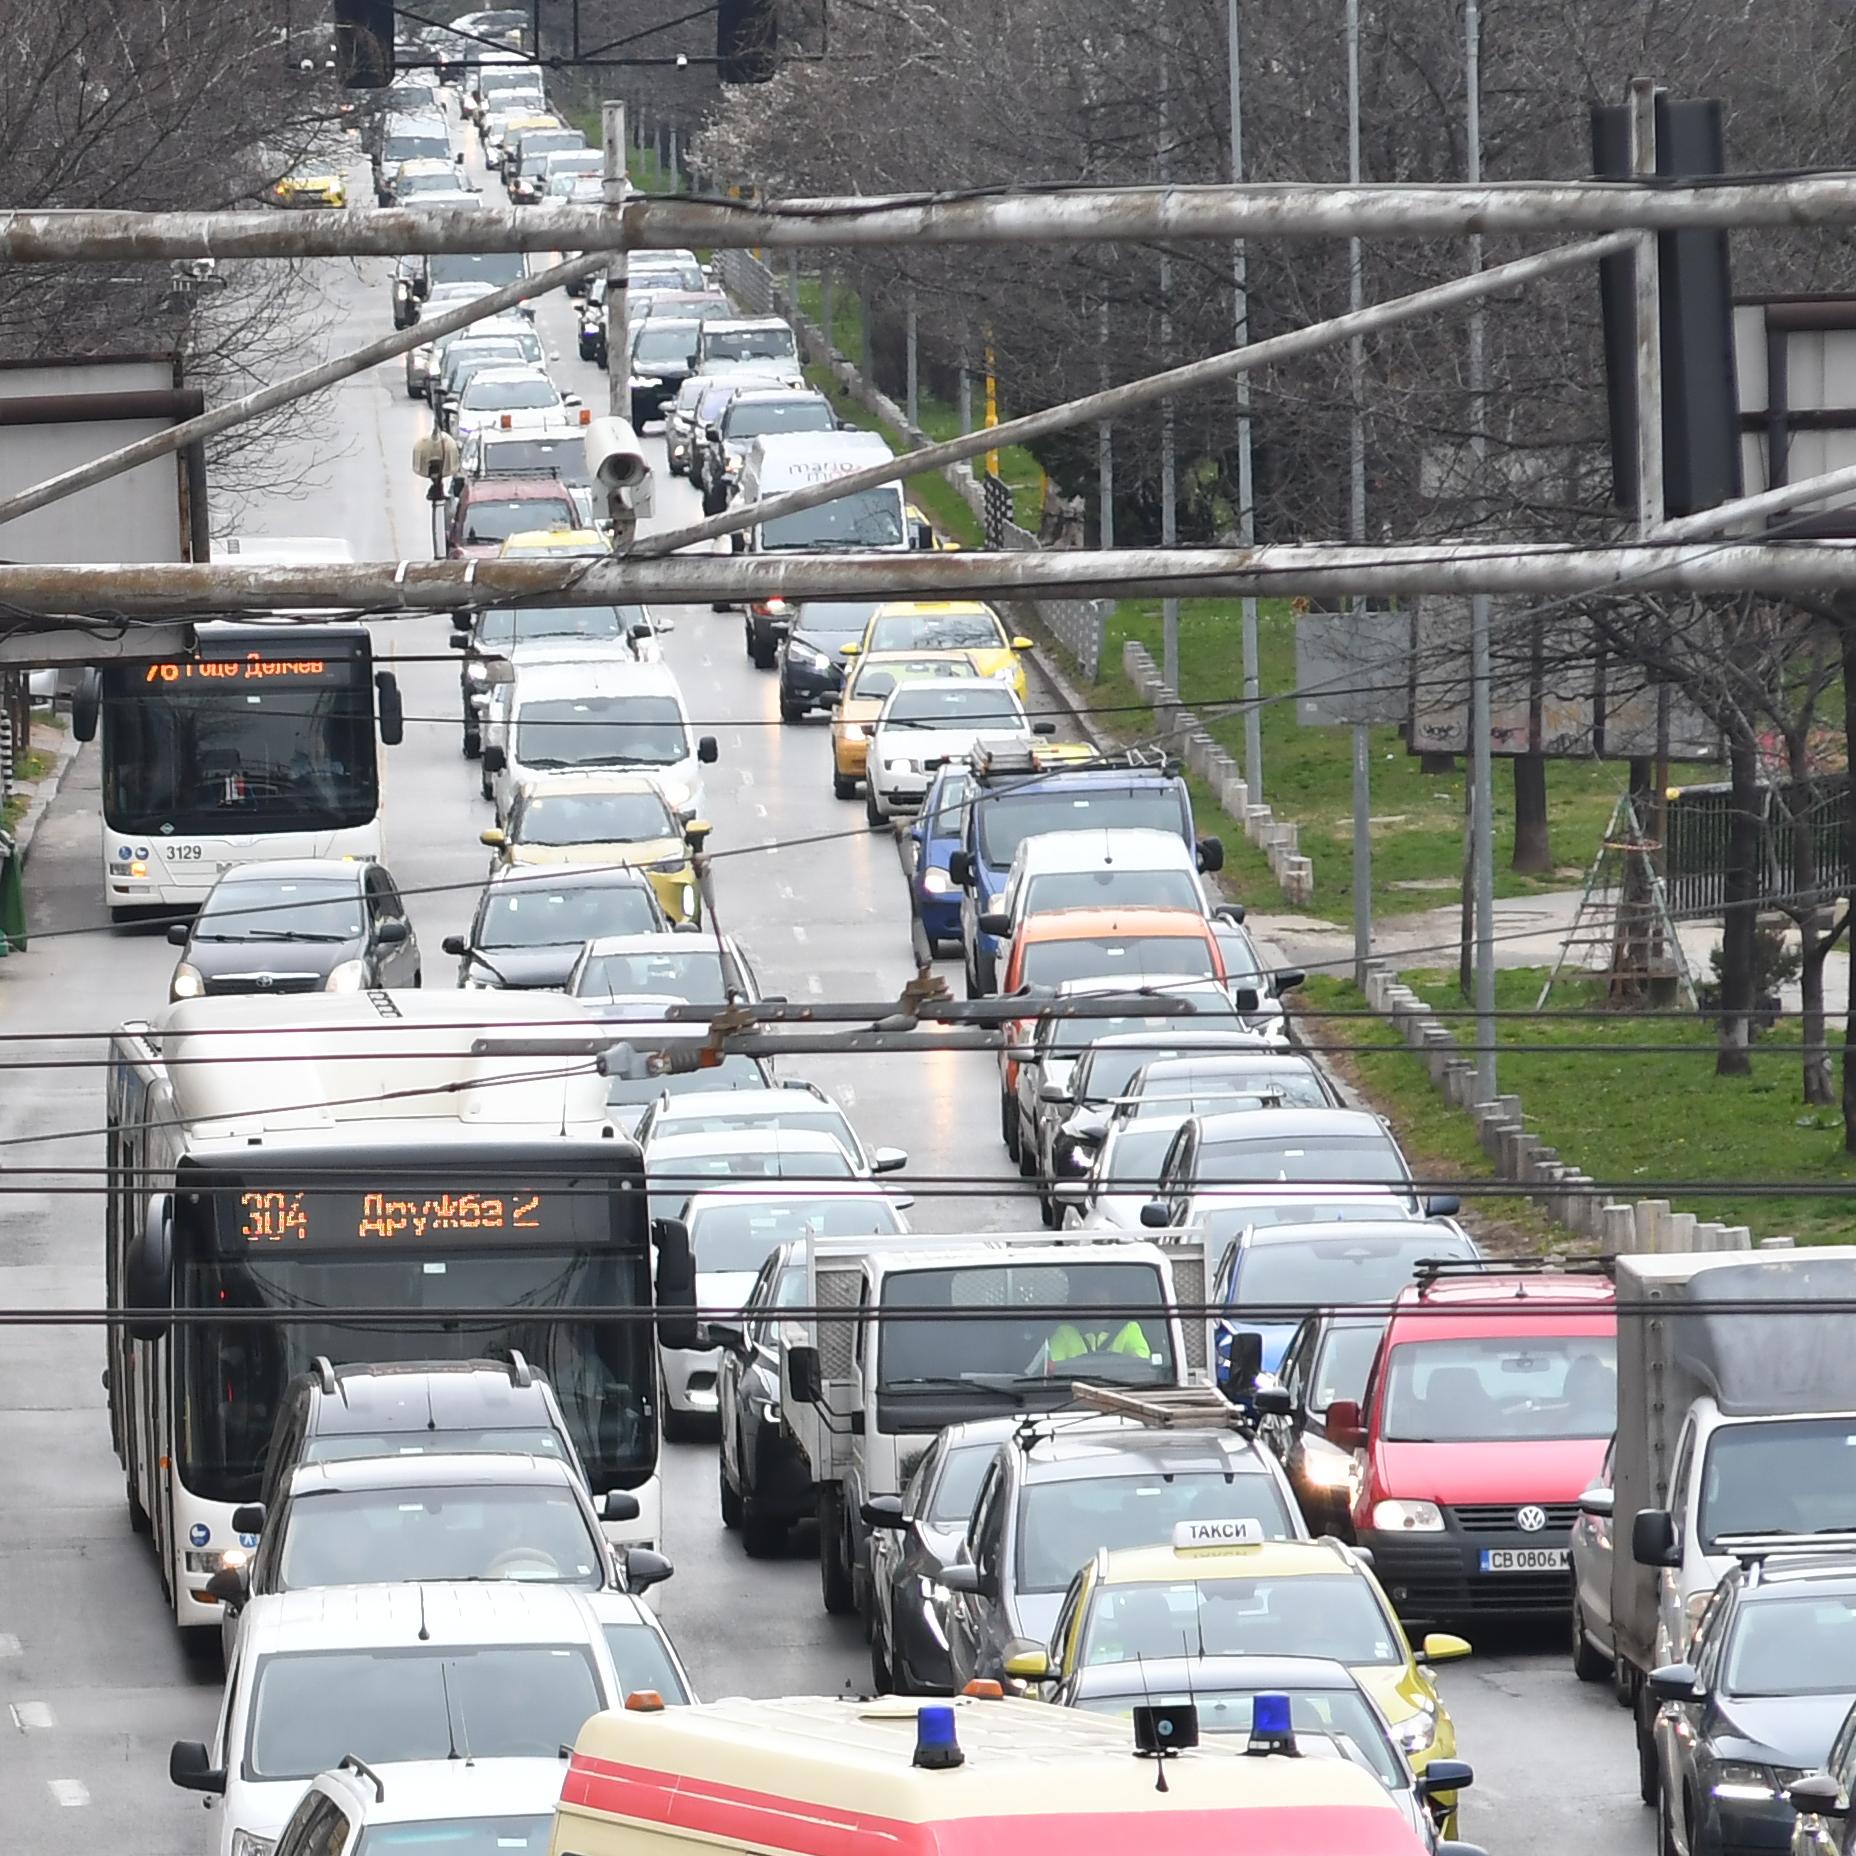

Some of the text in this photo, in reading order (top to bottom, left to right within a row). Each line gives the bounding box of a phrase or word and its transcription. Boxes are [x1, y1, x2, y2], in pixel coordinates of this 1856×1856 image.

[166, 845, 202, 860] 3129
[241, 1190, 540, 1240] 304 Дружба 2
[1190, 1524, 1247, 1538] ТАКСИ
[1517, 1552, 1557, 1567] 0806
[1560, 1551, 1570, 1567] M
